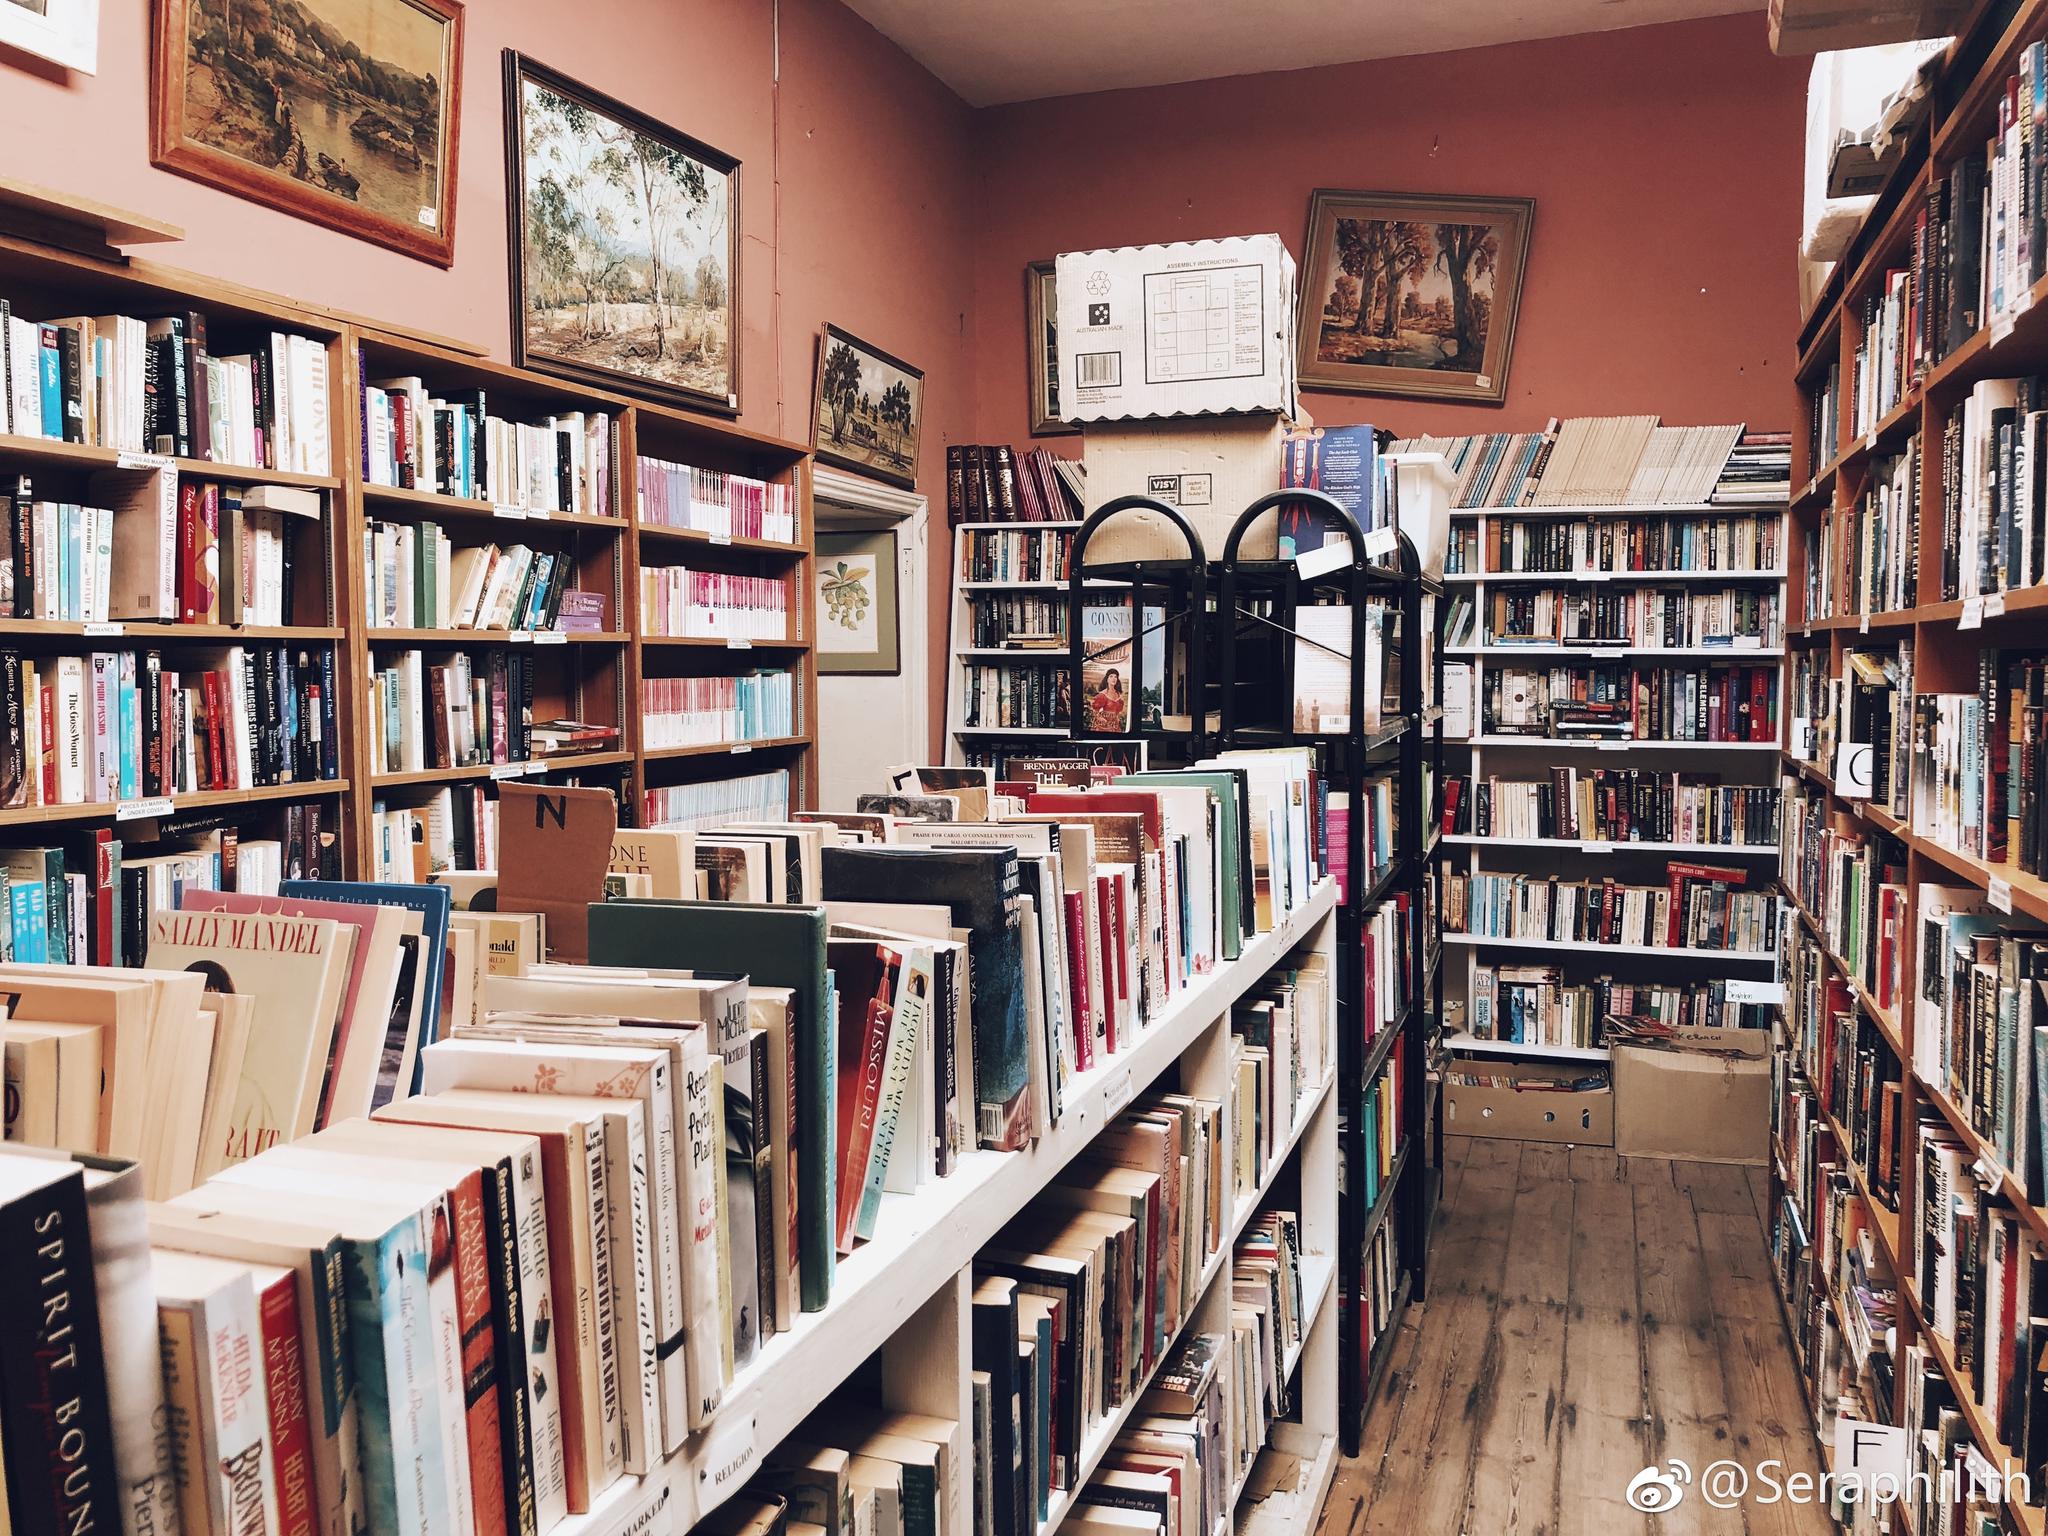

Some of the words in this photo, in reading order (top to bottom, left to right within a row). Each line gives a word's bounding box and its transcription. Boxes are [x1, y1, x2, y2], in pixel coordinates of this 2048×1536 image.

[1198, 258, 1238, 266] INSTRUCTIONS
[174, 335, 183, 366] TOUCHING
[176, 367, 186, 397] MIDNIGHT
[312, 357, 324, 390] THE
[178, 398, 186, 415] FIONA
[163, 471, 177, 515] ENDLESS
[185, 487, 196, 511] Taking
[1153, 480, 1176, 489] VISY
[166, 518, 176, 542] TIME
[97, 680, 106, 702] PRIDE
[246, 666, 254, 687] MARY
[69, 692, 78, 710] The
[247, 690, 256, 722] HIGGINS
[1988, 679, 1996, 722] FORD
[69, 712, 79, 734] Goss
[249, 724, 258, 750] CLARK
[284, 717, 290, 727] My
[70, 734, 79, 768] Women
[1058, 762, 1088, 771] JAGGER
[1034, 773, 1063, 784] THE
[536, 794, 566, 830] N
[16, 892, 26, 915] MAD
[30, 889, 42, 911] MAD
[300, 893, 330, 902] Large
[338, 895, 368, 904] Print
[377, 898, 428, 908] Romance
[152, 916, 225, 948] SALLY
[226, 918, 322, 954] MANDEL
[900, 999, 912, 1034] THE
[1985, 989, 1993, 1014] THE
[890, 1037, 904, 1082] MOST
[900, 1002, 924, 1086] JACQUELYN
[1985, 1016, 1993, 1065] NOBLE
[860, 1004, 888, 1130] MISSOURI
[698, 1096, 706, 1108] to
[1984, 1068, 1993, 1117] ENEMY
[874, 1092, 894, 1166] WANTED
[882, 1090, 902, 1170] MITCHARD
[590, 1152, 603, 1194] THE
[658, 1115, 673, 1211] Fashionistas
[499, 1166, 510, 1221] Return
[468, 1198, 488, 1301] TAMARA
[502, 1222, 510, 1239] to
[518, 1216, 534, 1280] Mead
[530, 1196, 546, 1281] Juliette
[664, 1215, 672, 1254] LYNN
[458, 1196, 476, 1318] McKINLEY
[505, 1240, 515, 1296] Peyton
[593, 1198, 613, 1336] DANGERFIELD
[34, 1210, 78, 1370] SPIRIT
[508, 1290, 518, 1334] Place
[638, 1300, 650, 1330] at
[232, 1333, 253, 1398] HILDA
[402, 1317, 416, 1384] Crimson
[440, 1307, 454, 1394] Footsteps
[642, 1333, 657, 1407] War
[214, 1328, 239, 1430] McKENZIE
[284, 1336, 305, 1422] LINDSAY
[601, 1339, 617, 1423] DIARIES
[268, 1336, 290, 1448] McKINNA
[284, 1448, 309, 1516] HEART
[547, 1410, 557, 1449] Jack
[55, 1396, 94, 1536] BOUN
[535, 1427, 544, 1470] Have
[714, 1446, 754, 1486] RELIGION
[1853, 1428, 1888, 1468] F
[537, 1474, 548, 1504] Jill
[551, 1452, 564, 1495] Shall
